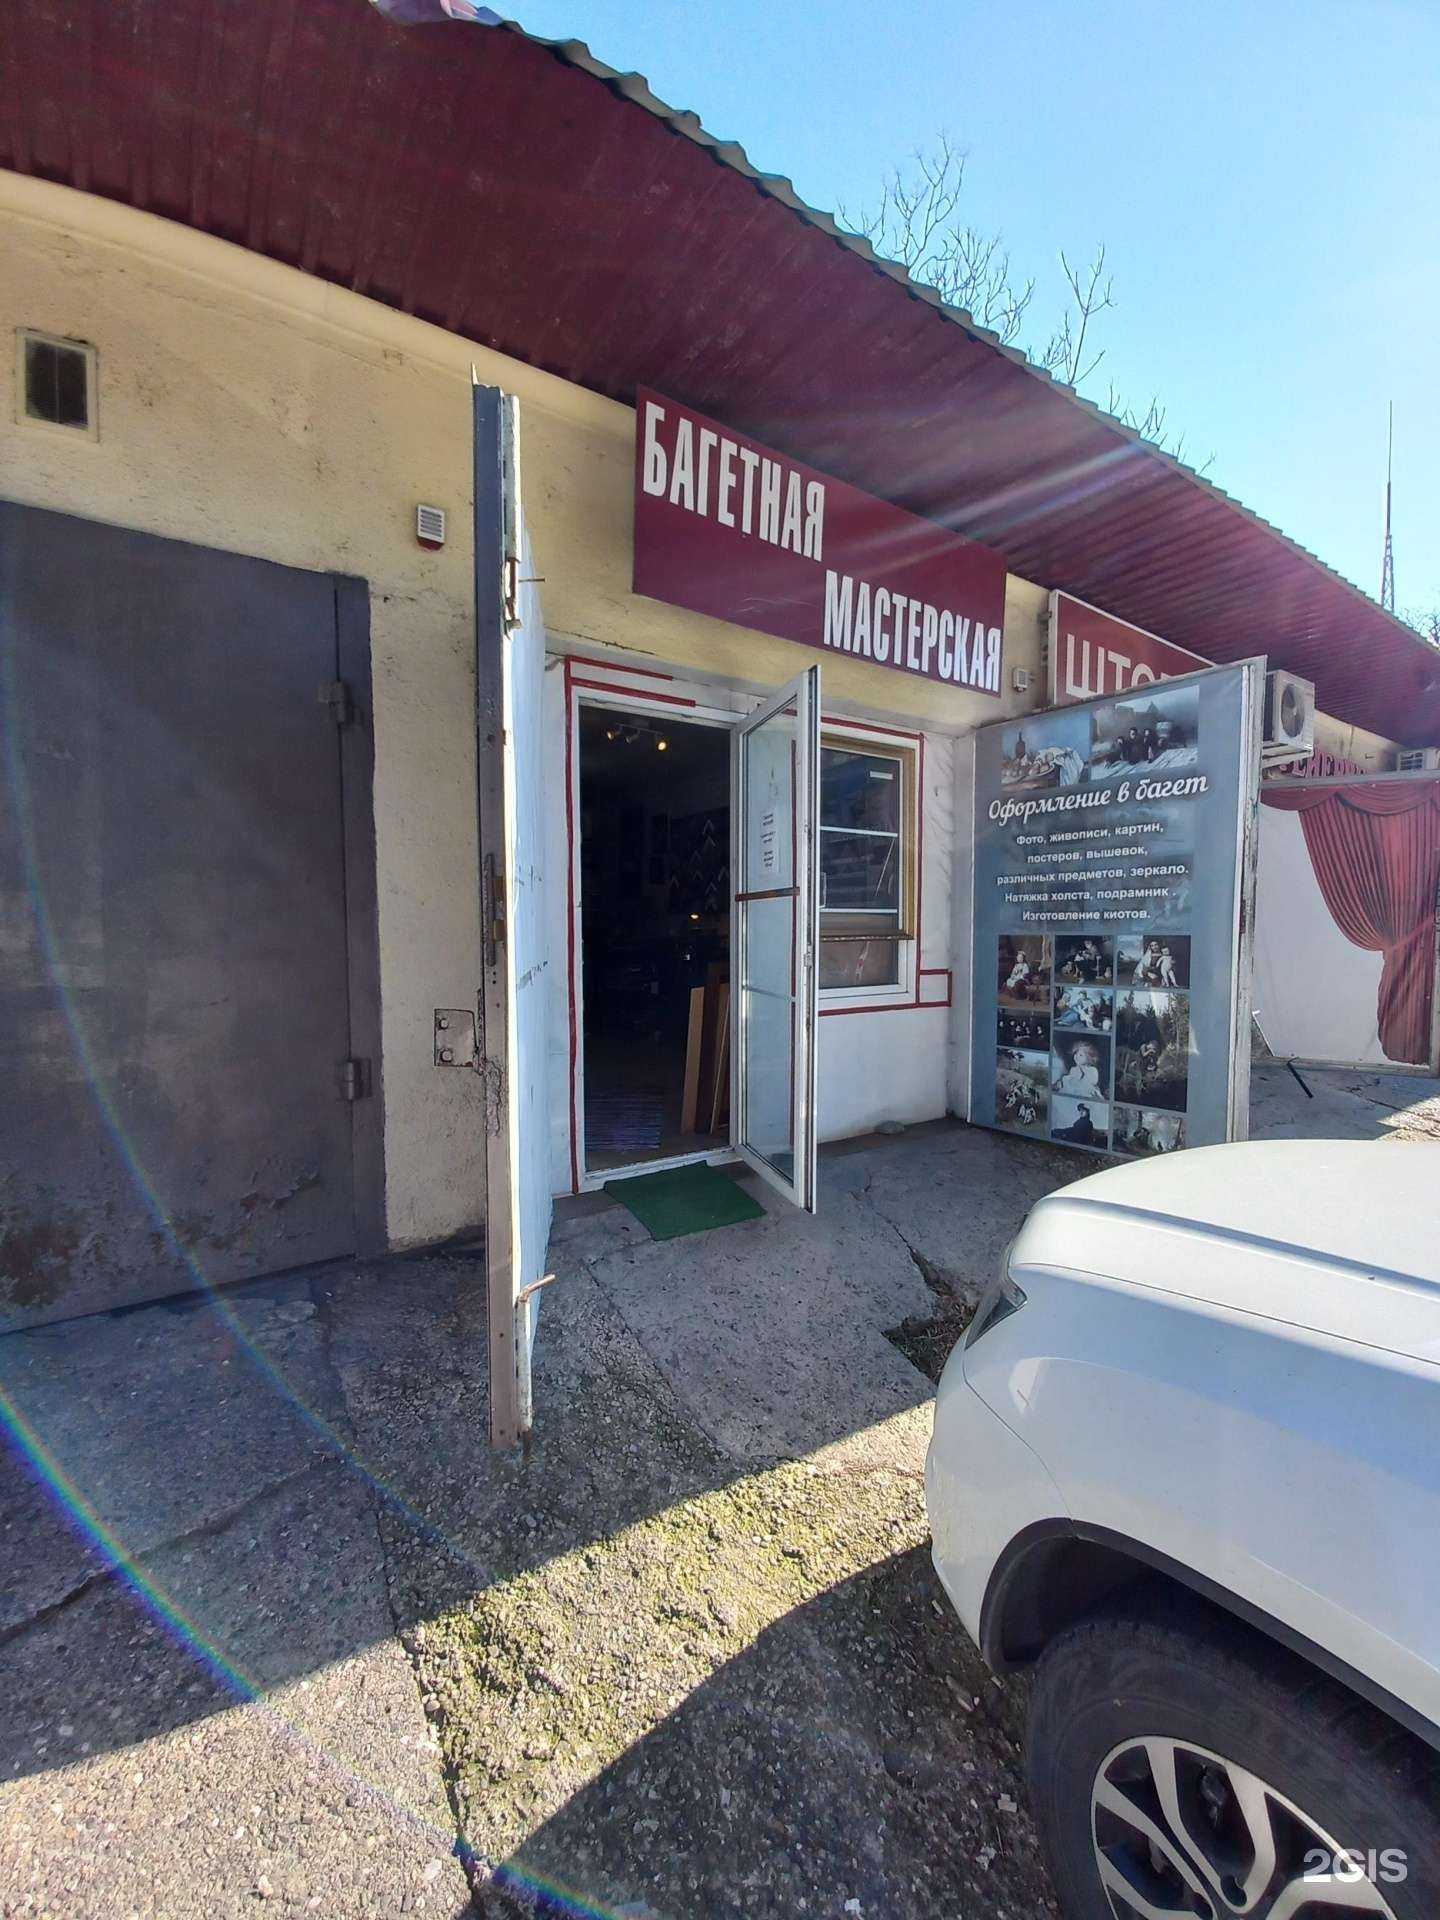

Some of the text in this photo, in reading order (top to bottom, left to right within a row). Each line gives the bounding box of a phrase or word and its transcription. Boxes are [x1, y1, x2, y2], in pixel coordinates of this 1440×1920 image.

[643, 401, 825, 561] БАГЕТНАЯ
[823, 569, 1001, 692] МАСТЕРСКАЯ
[988, 775, 1209, 827] Оформление в багет
[1016, 822, 1164, 845] Фото, живописи, картин,
[1027, 846, 1148, 864] постеров, вышевок,
[997, 864, 1189, 886] различных предметов, зеркало.
[1005, 892, 1048, 903] Натяжка
[1051, 891, 1093, 901] холста,
[1022, 910, 1151, 921] Изготовление киотов.
